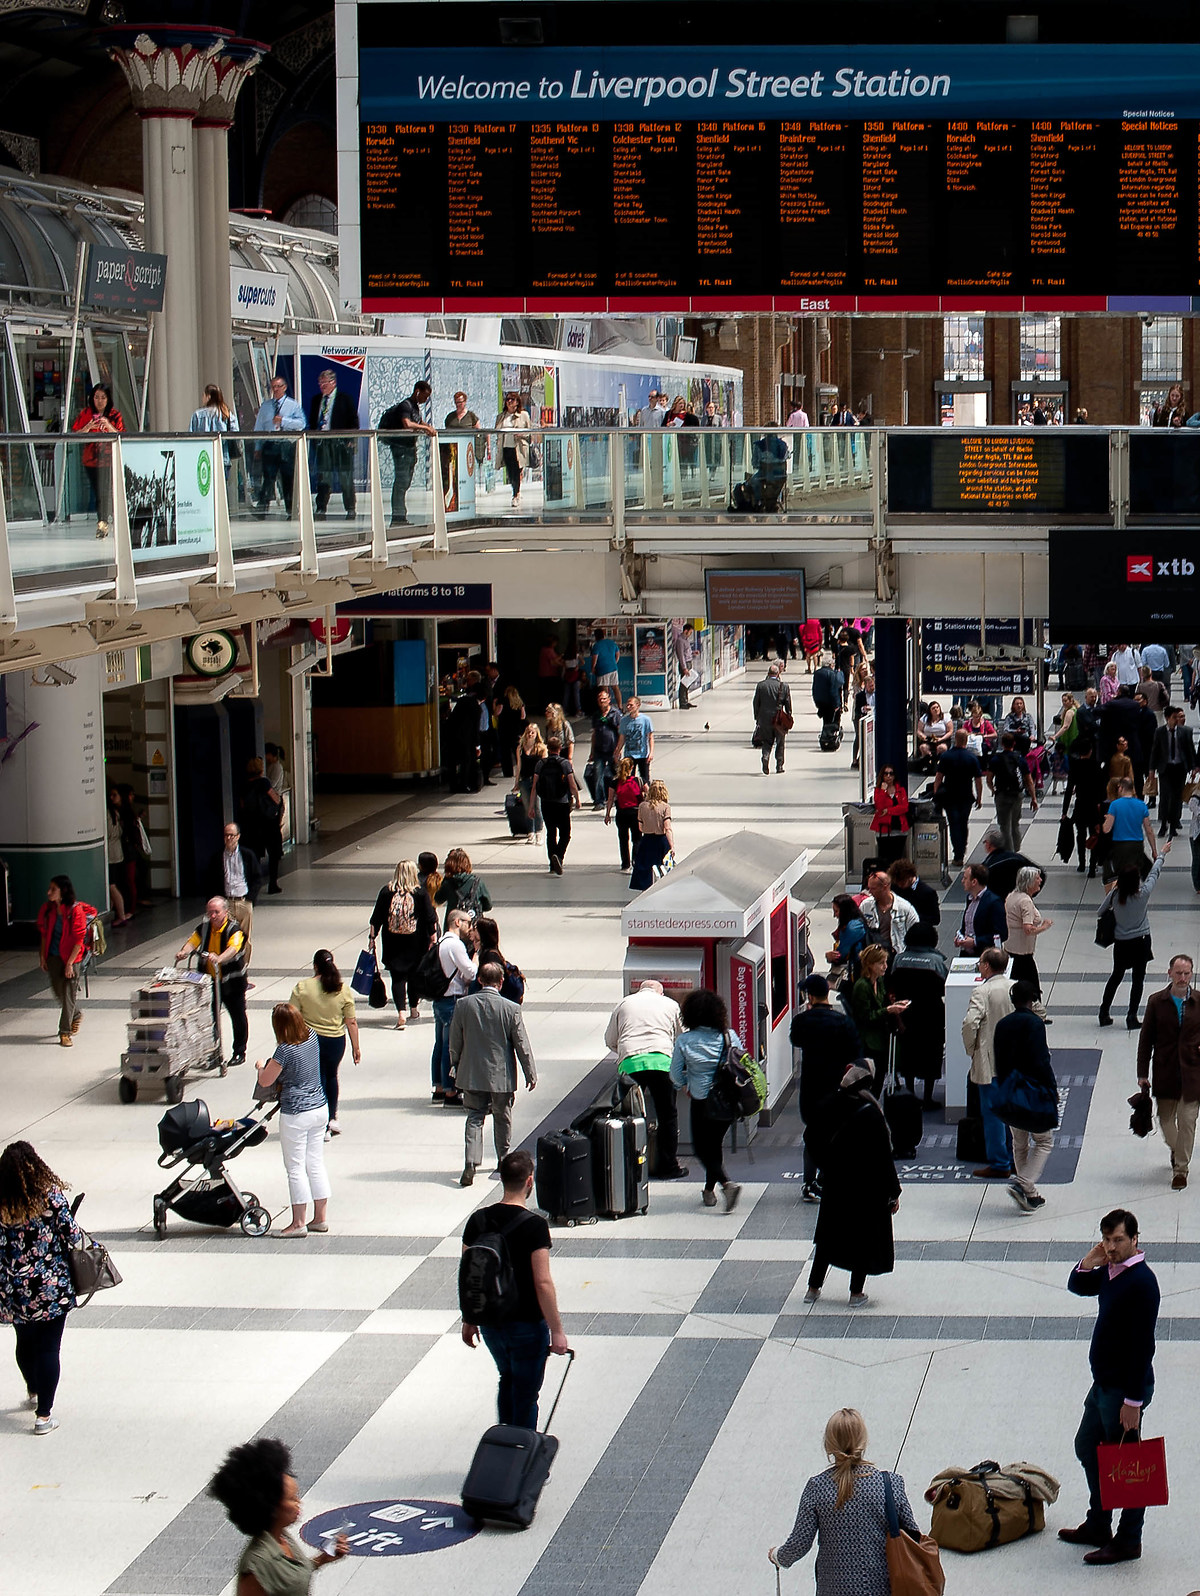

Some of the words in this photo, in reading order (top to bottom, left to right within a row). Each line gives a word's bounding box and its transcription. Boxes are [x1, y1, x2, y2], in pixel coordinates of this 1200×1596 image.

[416, 73, 531, 101] Welcome
[538, 76, 564, 99] to
[570, 67, 718, 107] Liverpool
[724, 68, 825, 99] Street
[832, 67, 951, 98] Station
[1123, 110, 1148, 119] Special
[1149, 110, 1175, 118] Notices
[396, 125, 426, 133] Platform
[557, 124, 587, 132] Platform
[640, 123, 670, 131] Platform
[723, 123, 754, 131] Platform
[893, 122, 924, 130] Platform
[977, 122, 1008, 130] Platform
[1061, 122, 1092, 130] Platform
[1122, 122, 1147, 131] Special
[1151, 122, 1177, 130] Notices
[238, 283, 276, 309] supercuts
[800, 299, 830, 310] East
[321, 345, 367, 355] NetworkRail
[1157, 558, 1195, 576] xtb
[431, 586, 439, 597] 8
[441, 586, 453, 597] to
[454, 586, 466, 597] 18
[944, 622, 966, 630] Station
[966, 623, 995, 632] recepion
[944, 665, 957, 673] Way
[627, 918, 738, 931] stanstedexpress.com
[738, 966, 746, 984] Buy
[738, 993, 747, 1018] Collect
[738, 1019, 748, 1048] tickets
[902, 1164, 966, 1172] your
[1107, 1457, 1157, 1483] Hamleys
